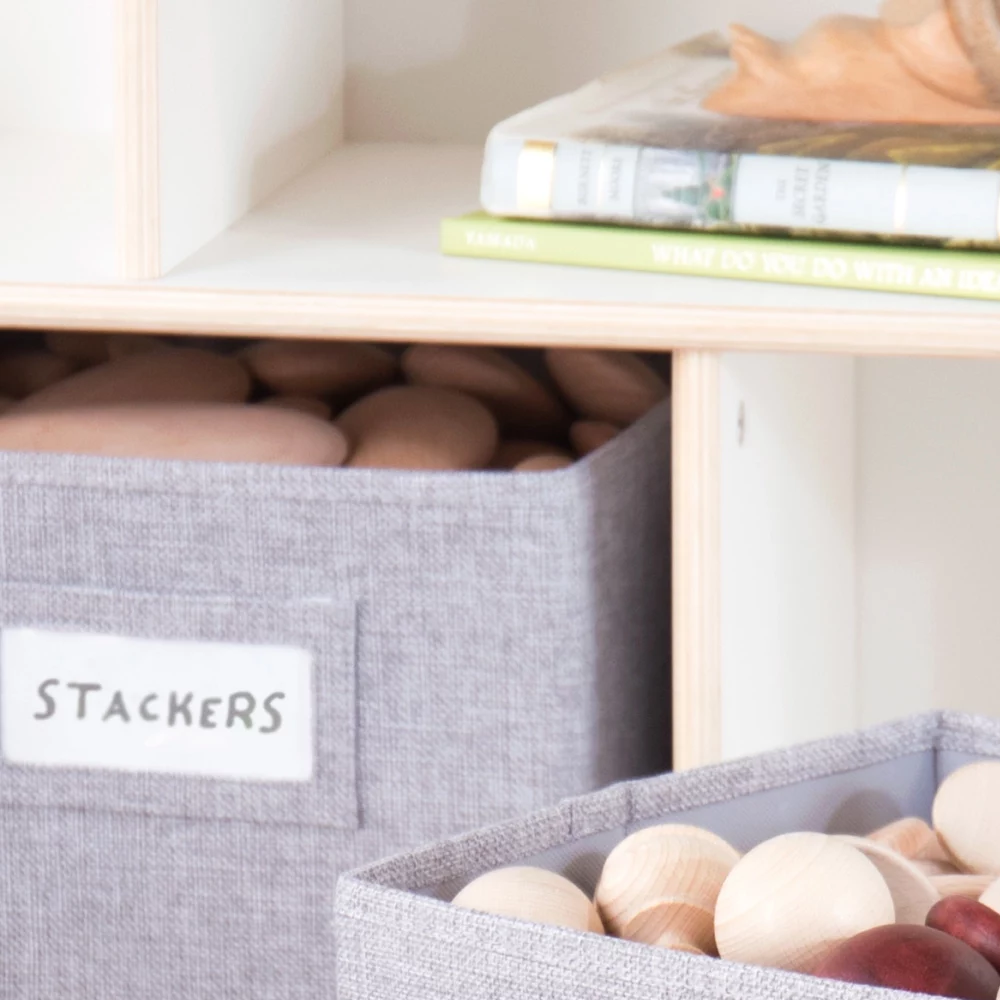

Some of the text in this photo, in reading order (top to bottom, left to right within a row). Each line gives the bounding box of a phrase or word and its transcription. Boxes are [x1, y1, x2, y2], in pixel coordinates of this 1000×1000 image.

[464, 230, 536, 251] YAMADA
[652, 243, 715, 268] WHAT
[720, 250, 755, 272] DO
[761, 252, 806, 276] YOU
[812, 257, 847, 280] DO
[852, 260, 916, 285] WITH
[918, 266, 954, 289] AN
[33, 677, 286, 734] STACKERS
